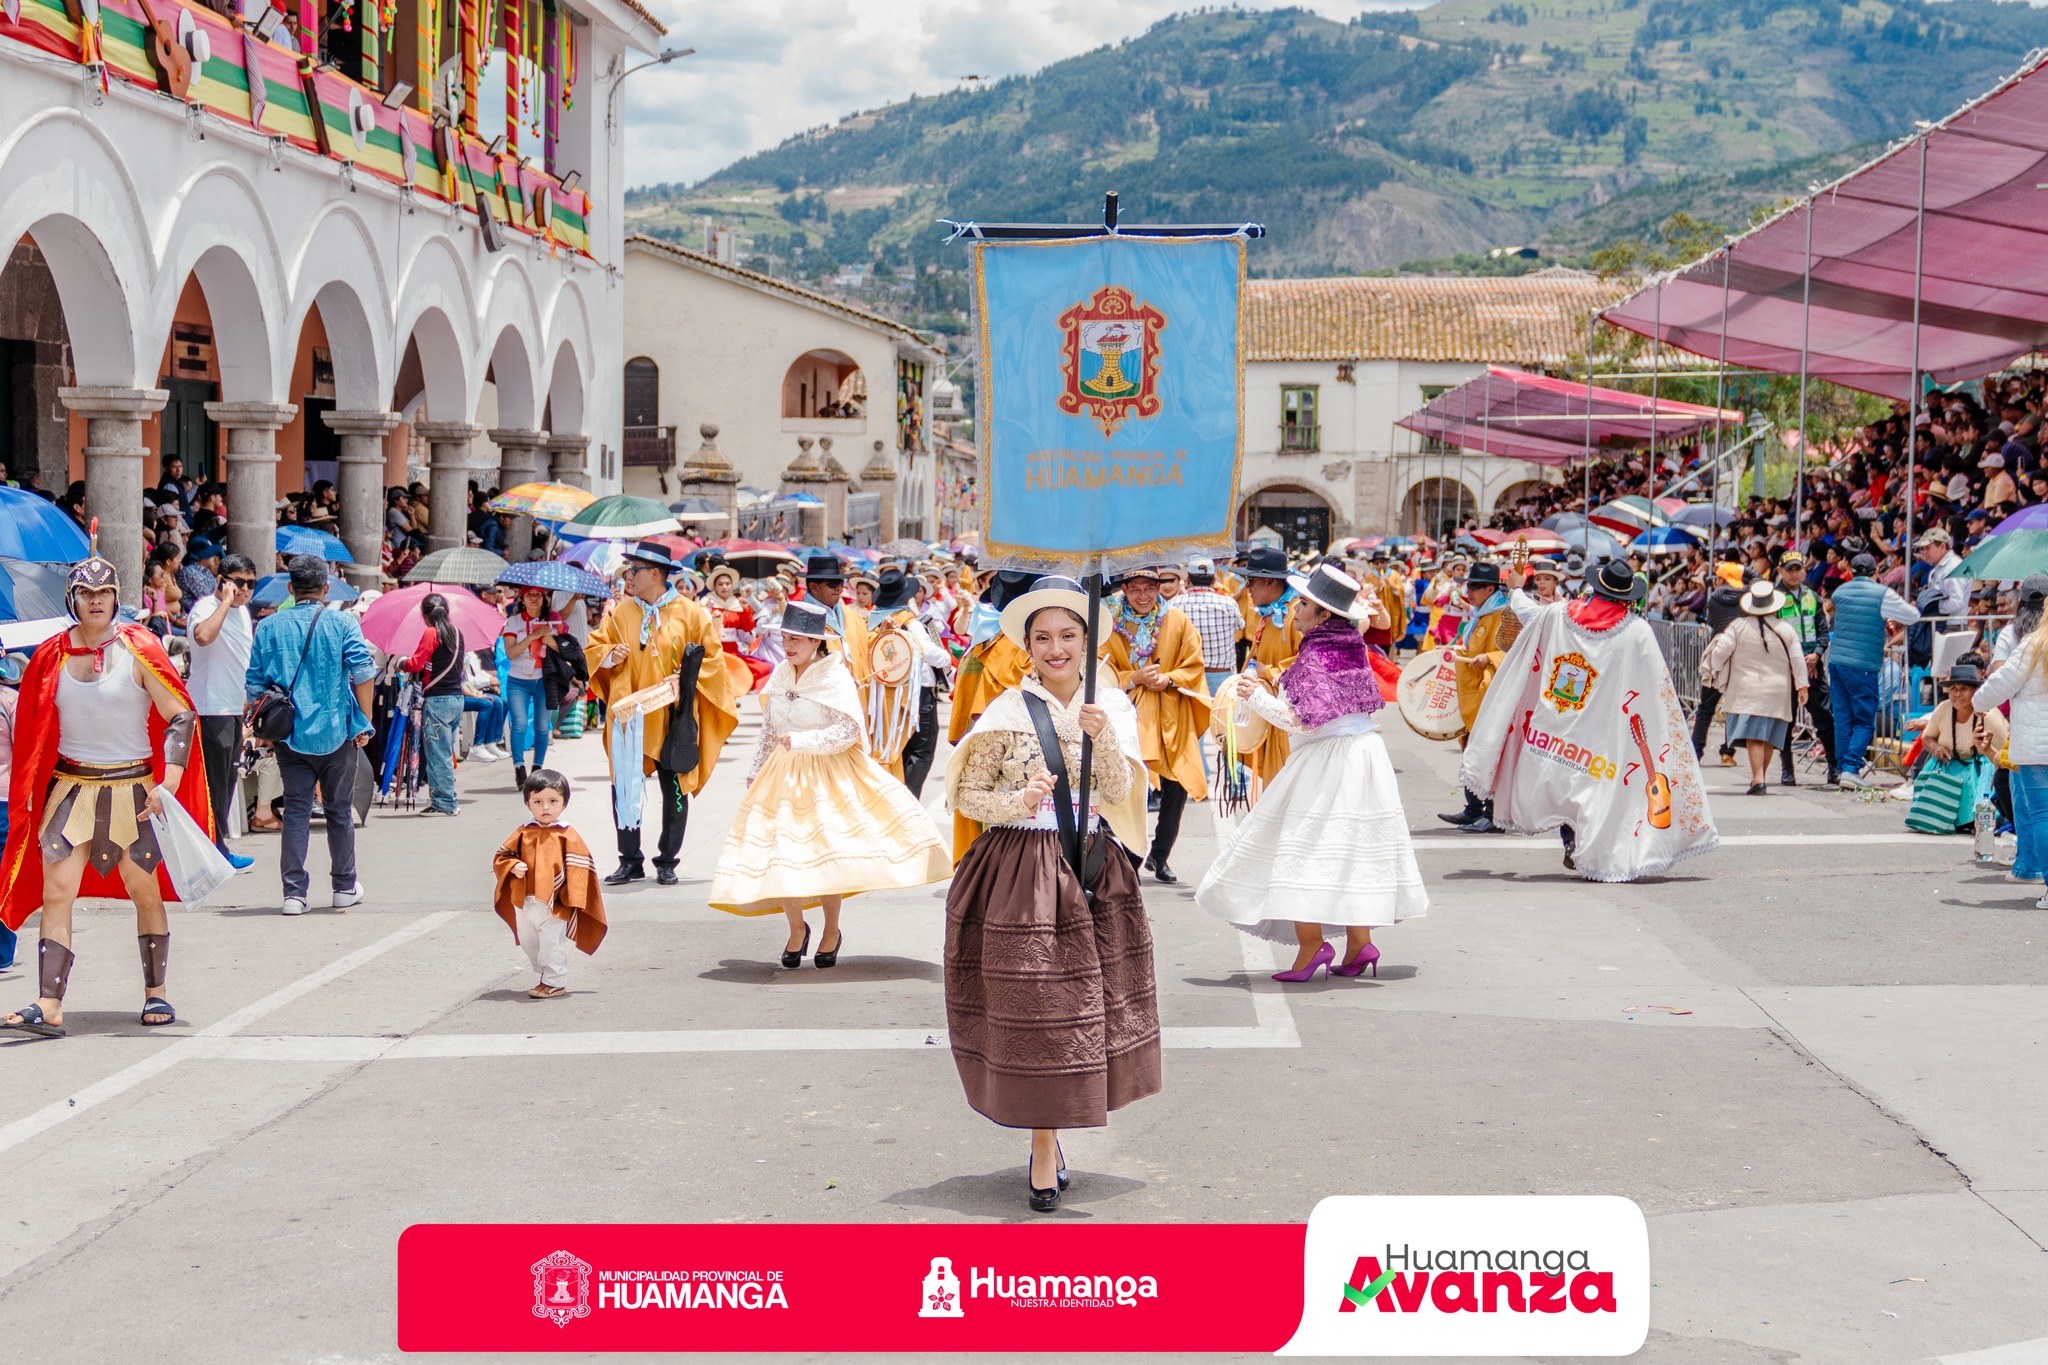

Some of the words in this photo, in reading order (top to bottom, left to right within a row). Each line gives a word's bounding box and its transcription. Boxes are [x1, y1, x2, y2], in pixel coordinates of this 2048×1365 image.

[1174, 448, 1189, 462] DE
[1026, 463, 1184, 491] HUAMANGA
[1438, 685, 1457, 710] Hua
[1525, 727, 1617, 780] uamanga
[1529, 746, 1553, 760] NUESTRA
[1552, 754, 1588, 774] IDENTIDAD
